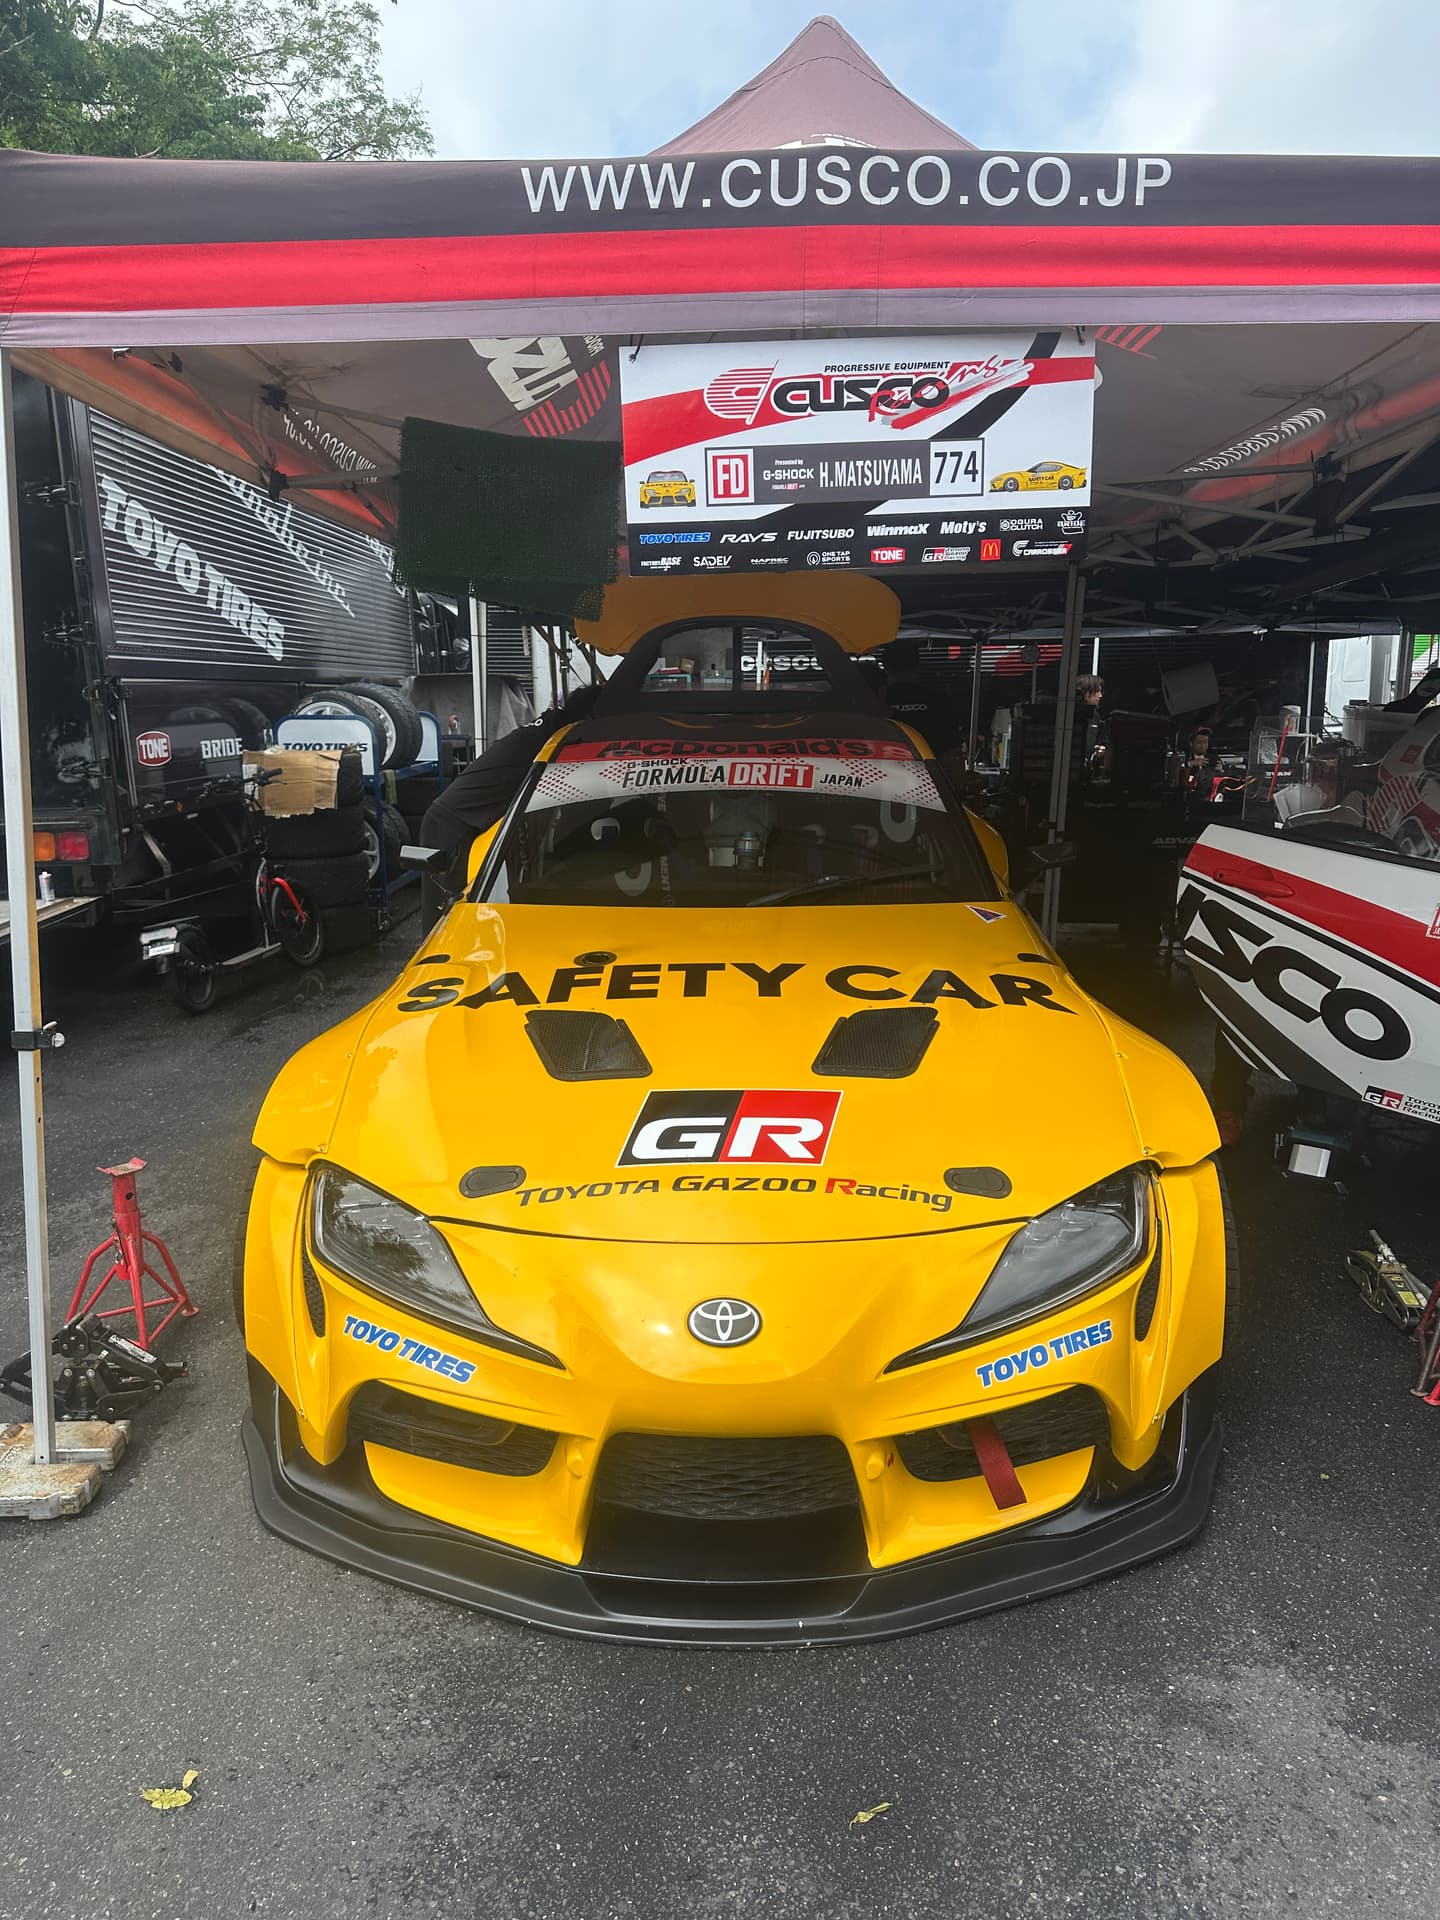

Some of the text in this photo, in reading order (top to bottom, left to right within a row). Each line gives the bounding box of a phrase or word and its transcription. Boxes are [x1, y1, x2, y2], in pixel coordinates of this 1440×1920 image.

[521, 156, 1172, 213] WWW.CUSCO.CO.JP
[824, 361, 950, 373] PROGRESSIVE EQUIPMENT
[773, 376, 950, 413] CUSCO
[717, 458, 745, 496] FD
[763, 468, 815, 480] G-SHOCK
[819, 458, 922, 488] H.MATSUYAMA
[934, 450, 979, 485] 774
[640, 532, 712, 544] TOYO TIRES
[720, 532, 778, 543] RAYS
[787, 529, 855, 541] FUJITSUBO
[940, 520, 987, 535] Moty's
[101, 473, 202, 595] TOYO
[205, 561, 286, 662] TIRES
[693, 555, 732, 567] SADEV
[873, 551, 905, 562] TONE
[140, 738, 170, 760] TONE
[200, 737, 244, 759] BRIDE
[283, 742, 369, 752] TOYO TIRS
[597, 740, 874, 758] McDonald's
[627, 757, 688, 769] G-SHOCK
[622, 763, 863, 789] FORMULA DRIFT JAPAN
[398, 962, 1079, 1015] SAFETY CAR
[1363, 1091, 1402, 1110] GR
[631, 1117, 824, 1159] GR
[515, 1175, 953, 1212] TOYOTA GAZOO Racing
[343, 1315, 476, 1383] TOYO TIRES
[977, 1320, 1112, 1387] TOYO TIRES
